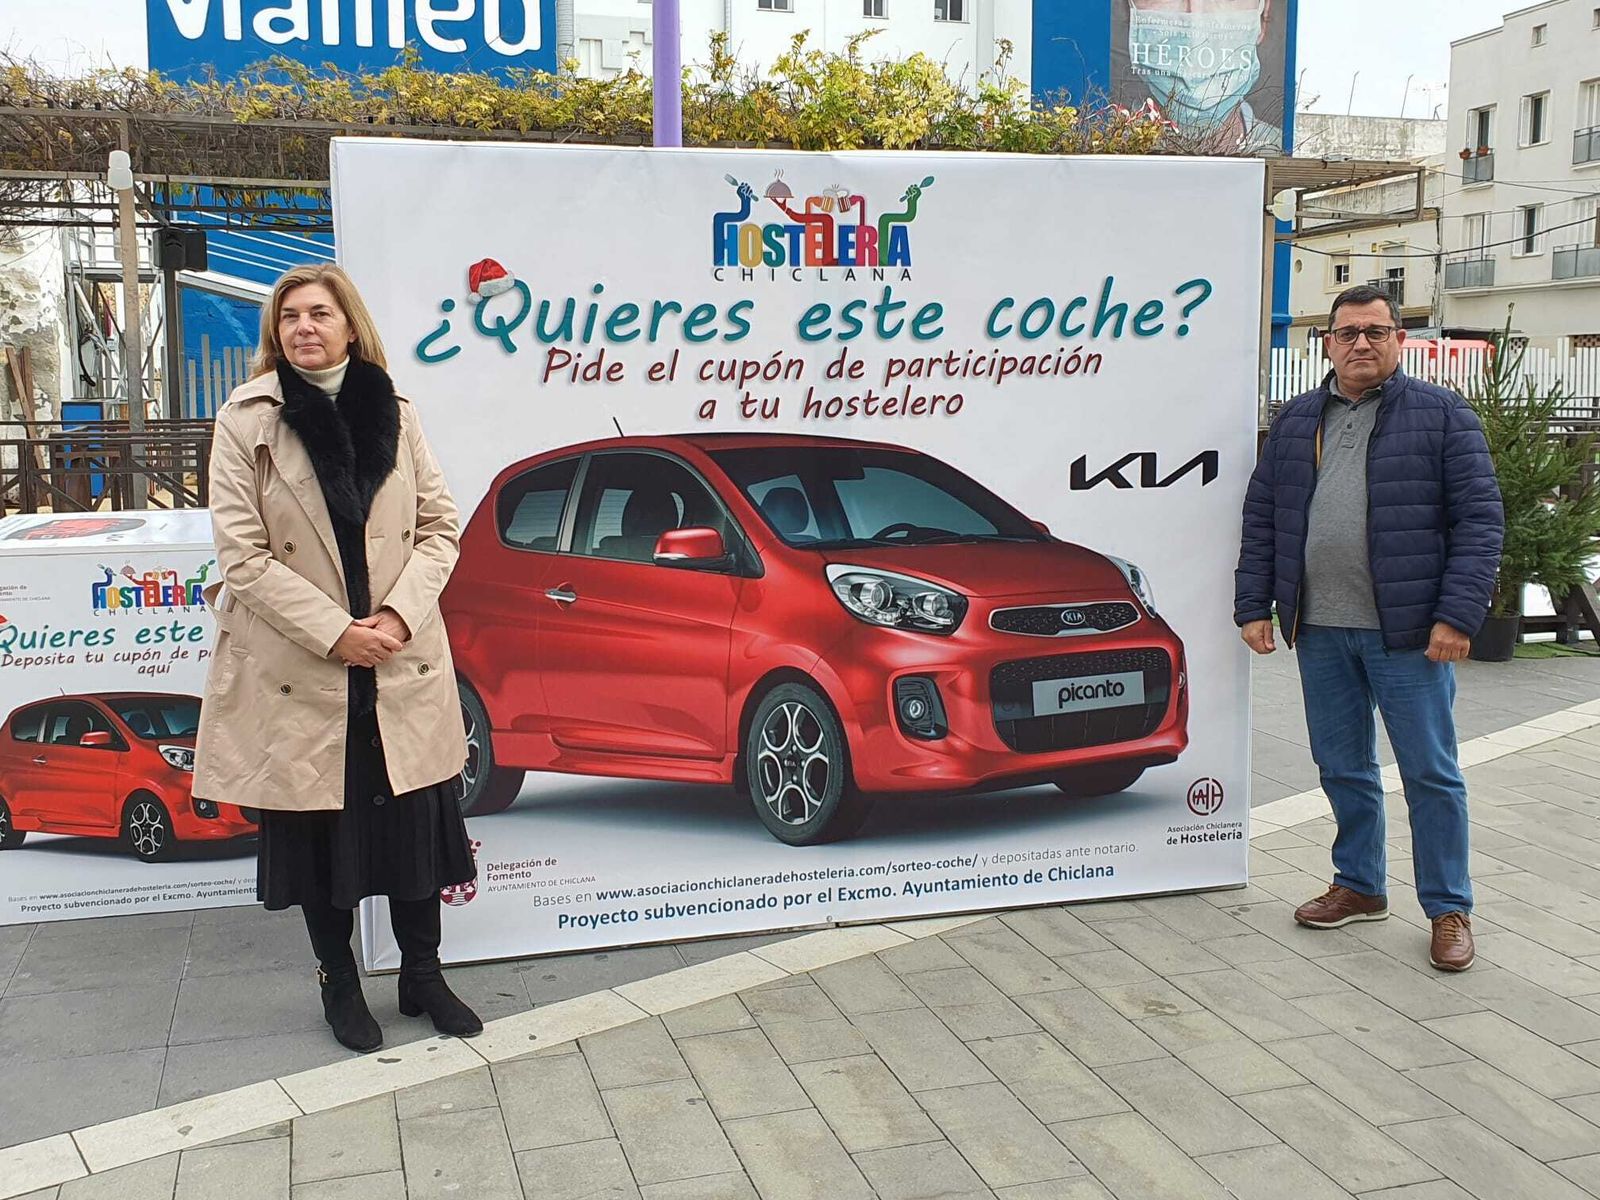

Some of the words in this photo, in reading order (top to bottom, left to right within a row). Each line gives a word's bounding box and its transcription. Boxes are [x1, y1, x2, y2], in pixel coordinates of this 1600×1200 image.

[1131, 39, 1252, 72] HÉROES
[714, 268, 912, 282] CHICLANA
[415, 278, 754, 364] ¿Quieres
[798, 285, 944, 342] este
[986, 275, 1213, 340] coche?
[543, 347, 625, 384] Pide
[648, 348, 679, 383] el
[700, 350, 804, 389] cupón
[826, 346, 865, 380] de
[885, 345, 1102, 387] participación
[698, 399, 717, 420] a
[740, 391, 780, 419] tu
[802, 384, 963, 419] hostelero
[93, 606, 207, 617] CHICLANA
[135, 619, 204, 645] este
[1, 652, 75, 669] Deposita
[86, 651, 104, 663] tu
[114, 648, 161, 664] cupón
[170, 646, 189, 660] de
[137, 661, 173, 677] aquí
[1058, 679, 1125, 709] picanto
[1166, 836, 1178, 845] de
[1180, 829, 1243, 844] Hostelería
[1167, 824, 1204, 833] Asociación
[1206, 821, 1242, 830] Chiclanera
[486, 859, 542, 872] Delegación
[544, 857, 557, 867] de
[486, 871, 532, 882] Fomento
[487, 880, 546, 892] AYUNTAMIENTO
[547, 879, 558, 887] DE
[559, 876, 596, 886] CHICLANA
[533, 894, 572, 907] Bases
[575, 893, 592, 903] en
[981, 857, 989, 867] y
[991, 848, 1062, 865] depositadas
[1065, 846, 1090, 858] ante
[21, 902, 62, 912] Proyecto
[64, 896, 132, 909] subvencionado
[134, 896, 149, 905] por
[152, 893, 160, 901] el
[163, 891, 194, 901] Excmo.
[558, 908, 639, 929] Proyecto
[644, 893, 778, 920] subvencionado
[783, 894, 812, 910] por
[817, 887, 832, 903] el
[838, 884, 897, 902] Excmo.
[902, 871, 1019, 897] Ayuntamiento
[1023, 868, 1043, 885] de
[1048, 864, 1114, 882] Chiclana
